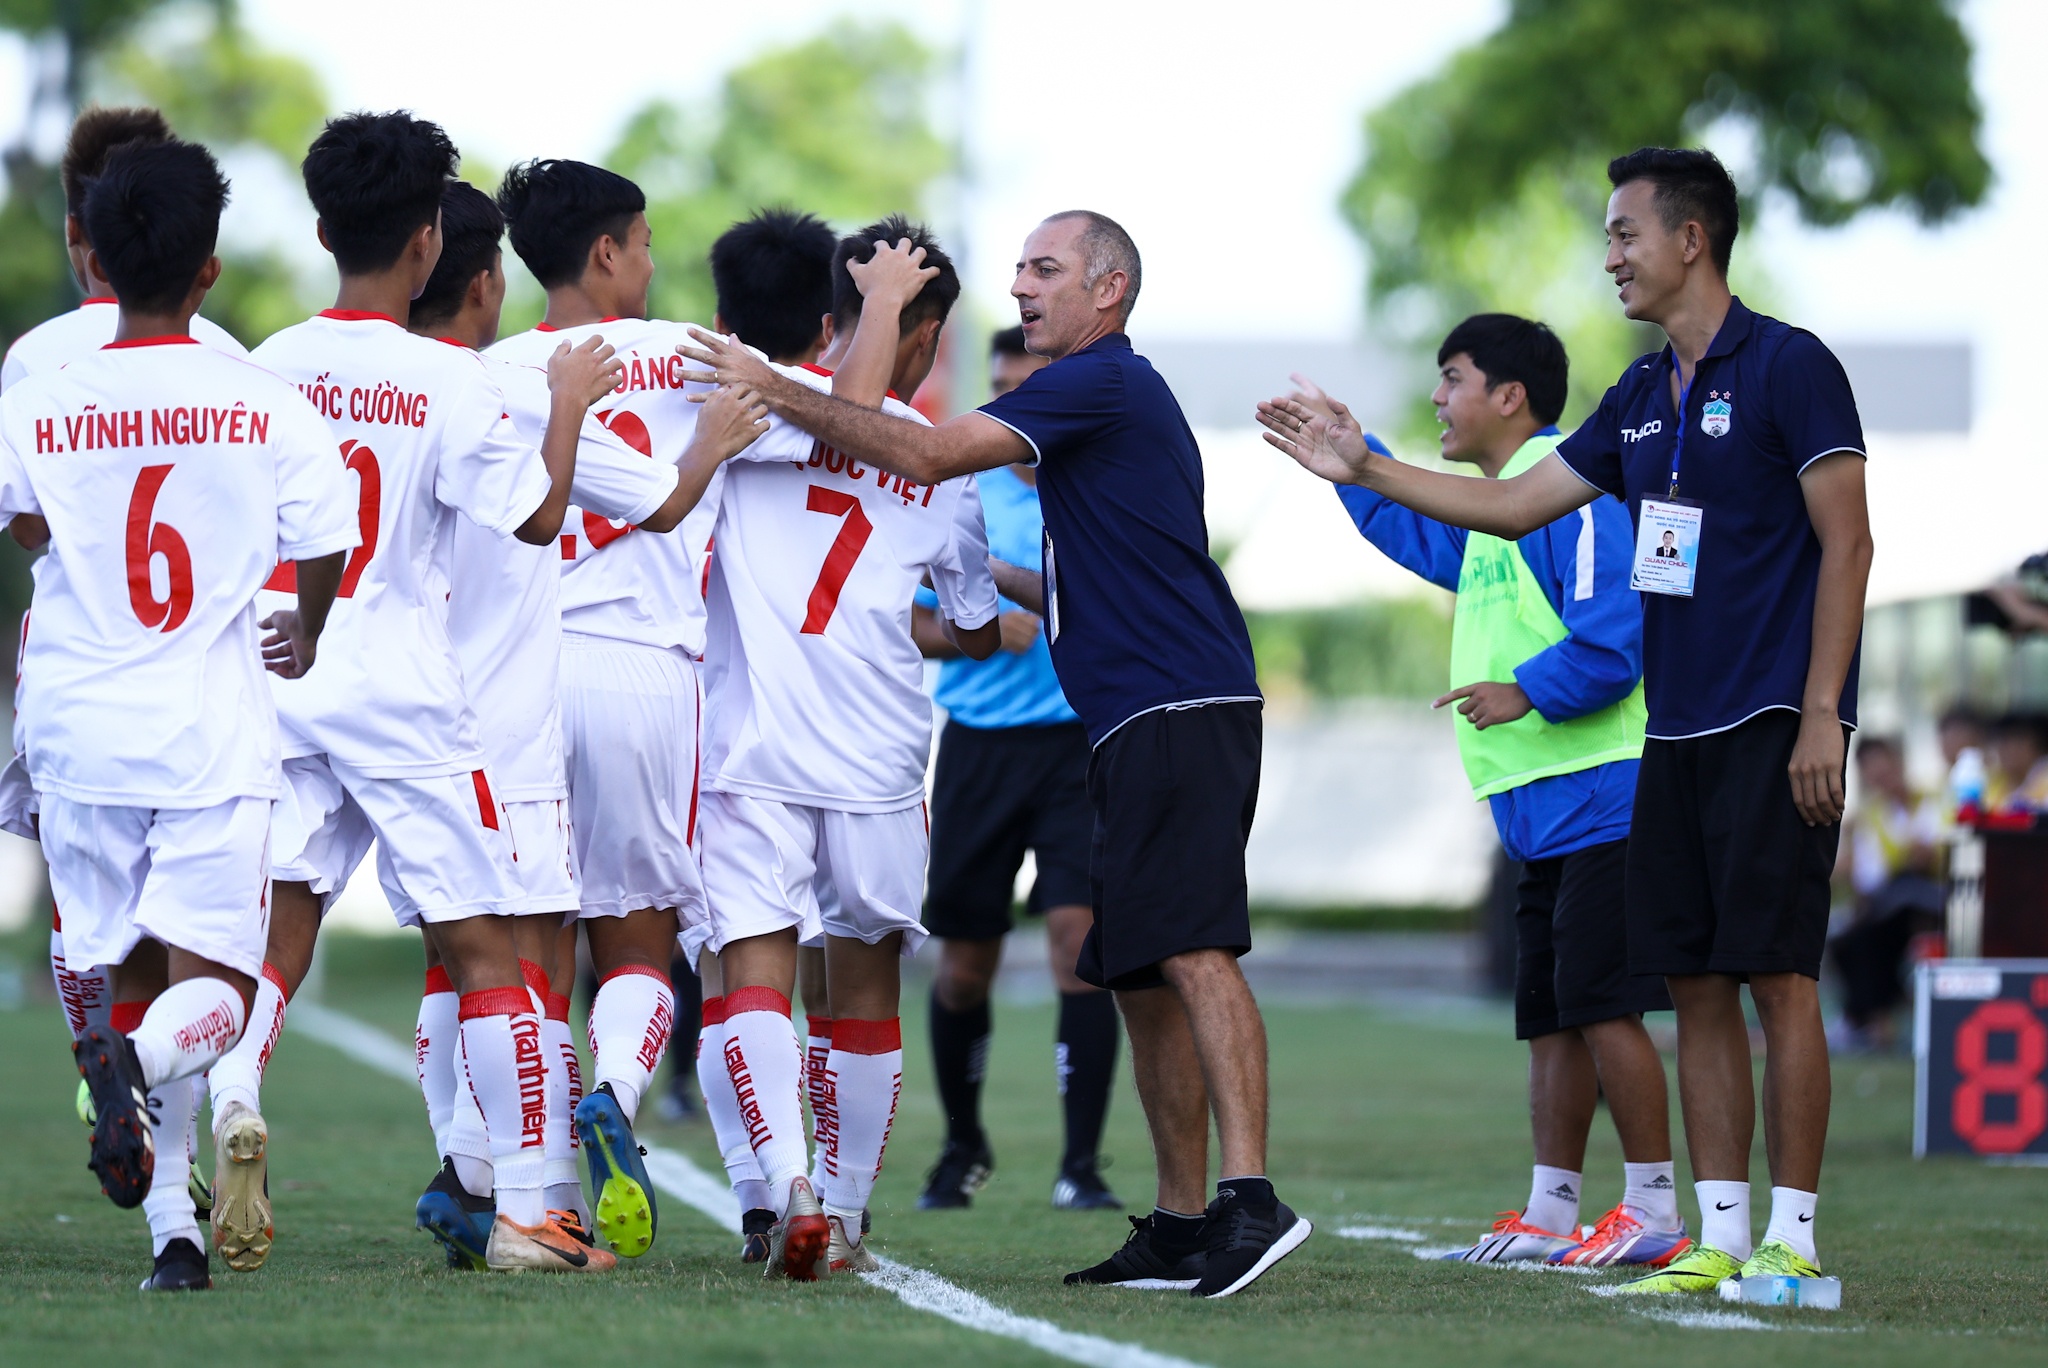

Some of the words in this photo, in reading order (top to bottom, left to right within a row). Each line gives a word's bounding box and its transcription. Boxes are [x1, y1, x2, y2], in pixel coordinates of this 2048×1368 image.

[604, 350, 684, 394] OÀNG
[36, 403, 143, 454] H.VĨNH
[152, 401, 270, 446] NGUYÊN
[350, 380, 428, 428] CƯỜNG
[1621, 419, 1662, 443] THACO
[125, 463, 194, 633] 6
[799, 484, 874, 636] 7
[1951, 998, 2048, 1154] 8
